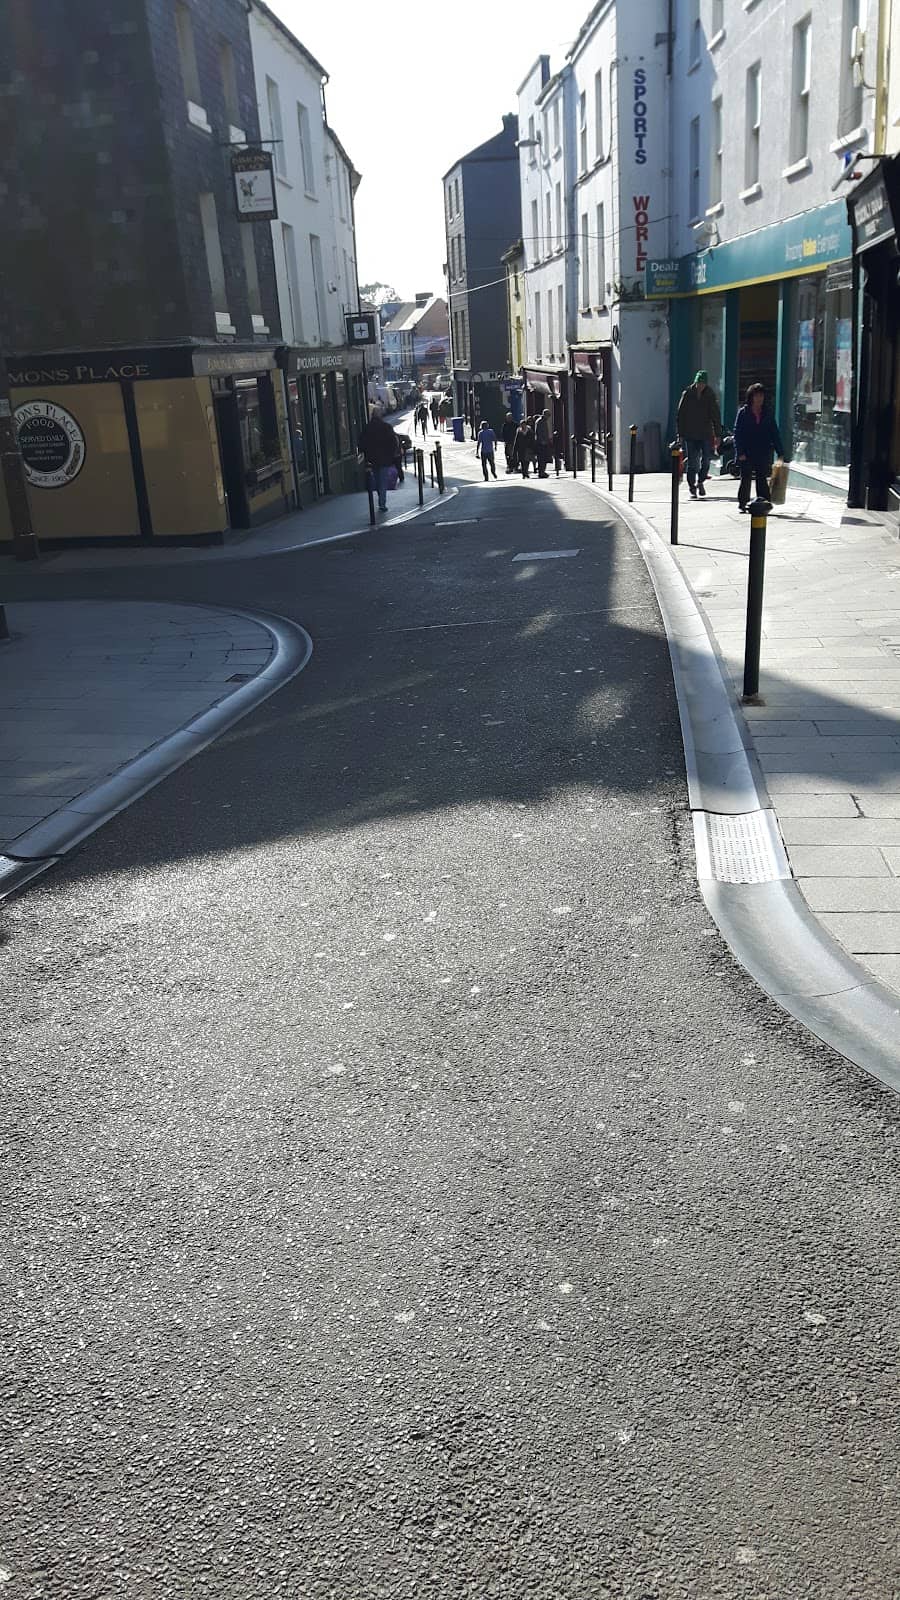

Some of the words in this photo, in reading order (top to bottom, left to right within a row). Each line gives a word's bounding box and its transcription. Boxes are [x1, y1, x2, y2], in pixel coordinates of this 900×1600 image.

[633, 69, 647, 164] SPORTS
[633, 196, 649, 272] WORLD
[651, 261, 680, 272] Dealz
[8, 368, 70, 384] MONS
[76, 363, 150, 380] PLACE
[26, 418, 55, 430] FOOD
[46, 404, 80, 440] PLACE
[20, 434, 47, 443] SERVED
[46, 433, 66, 442] DAILY
